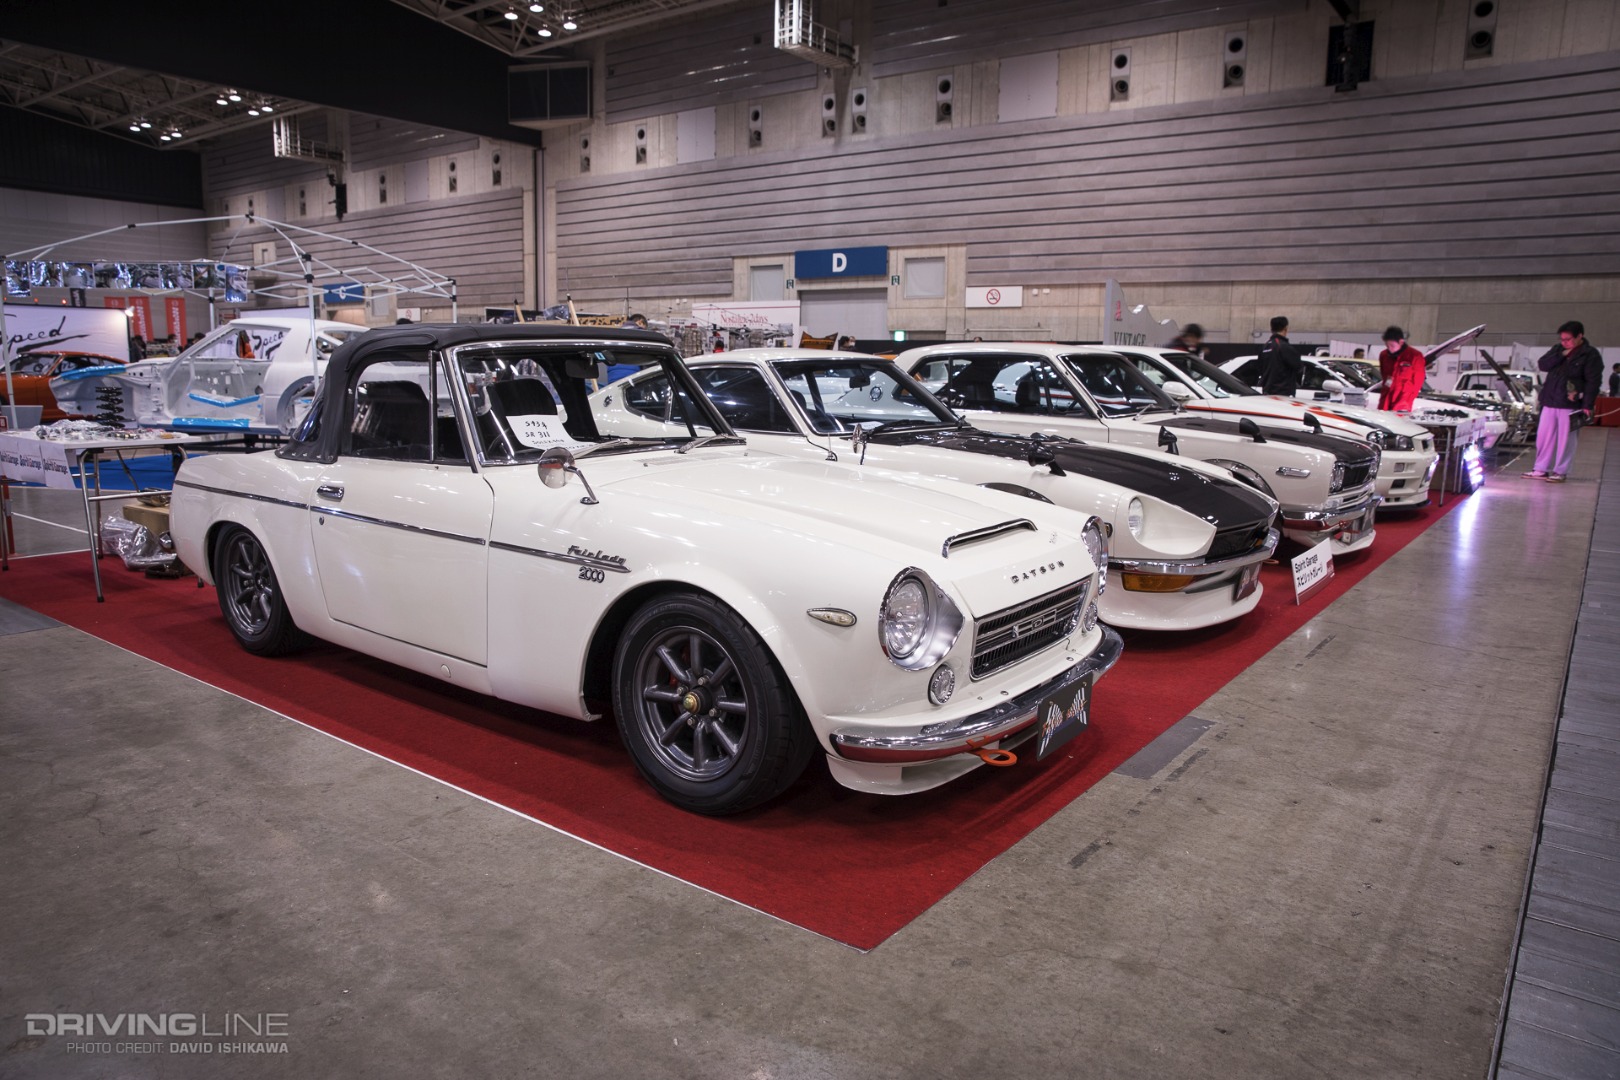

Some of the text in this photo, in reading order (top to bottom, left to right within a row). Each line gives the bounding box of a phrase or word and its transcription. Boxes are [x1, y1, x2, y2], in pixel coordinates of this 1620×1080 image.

[832, 252, 848, 273] D
[1114, 331, 1147, 346] VINTAGE
[567, 545, 627, 566] Fairlady
[578, 565, 605, 583] 2000
[1010, 560, 1065, 584] DATSUN
